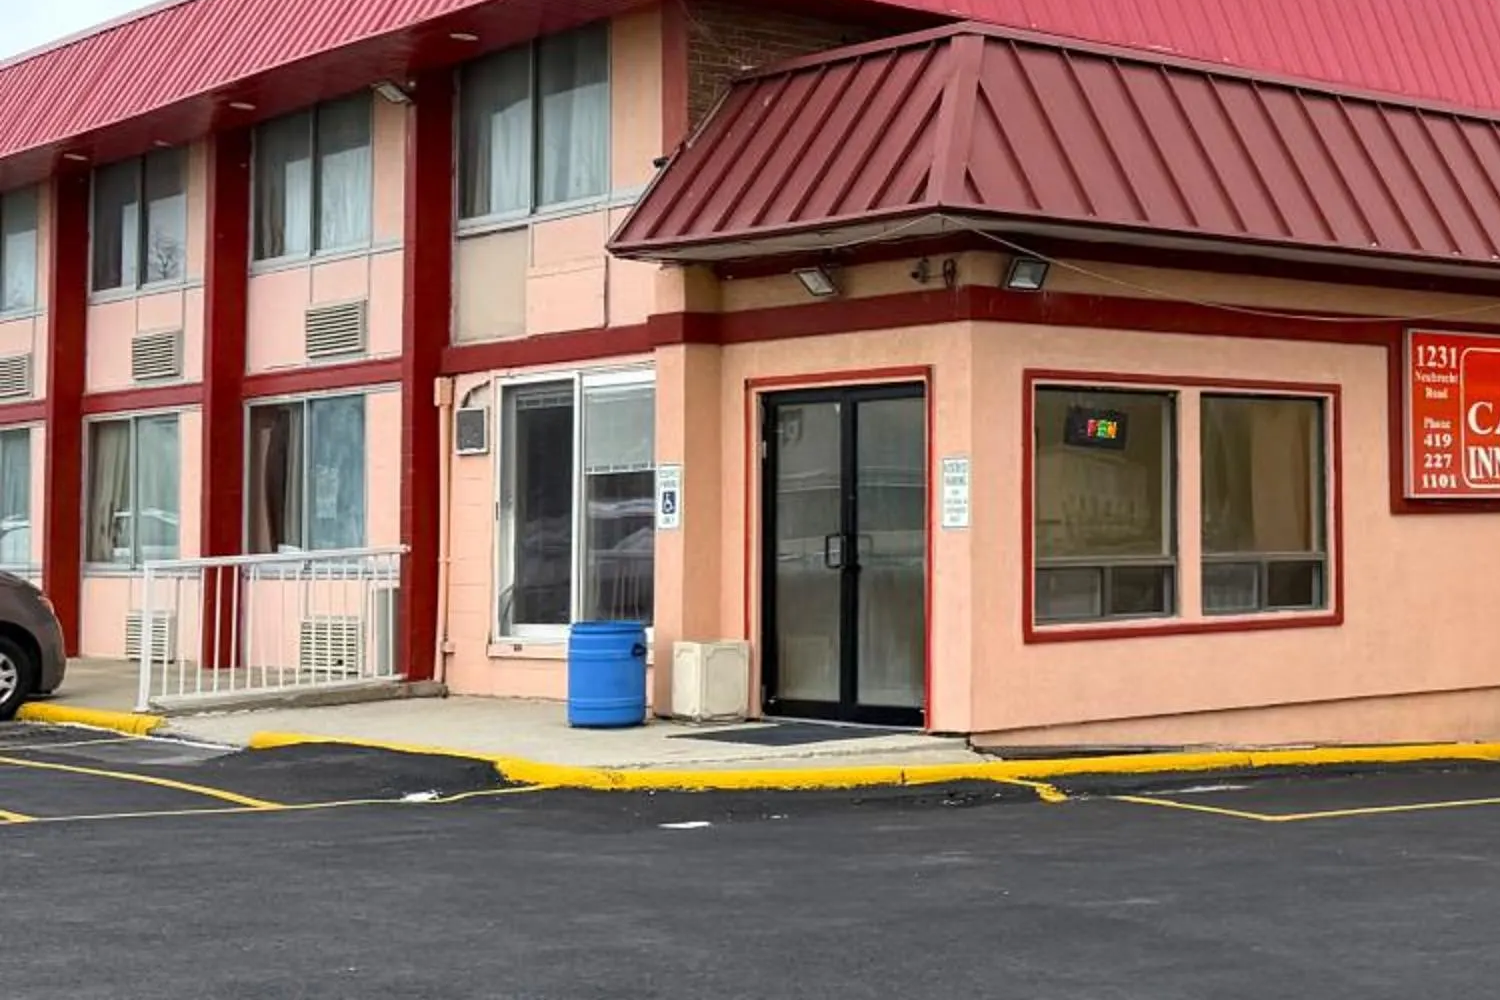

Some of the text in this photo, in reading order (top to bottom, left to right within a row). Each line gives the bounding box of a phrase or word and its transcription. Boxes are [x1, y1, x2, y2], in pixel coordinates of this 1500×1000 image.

[1416, 344, 1457, 369] 1231
[1423, 432, 1453, 449] 419
[1423, 453, 1453, 469] 227
[1421, 472, 1458, 489] 1101
